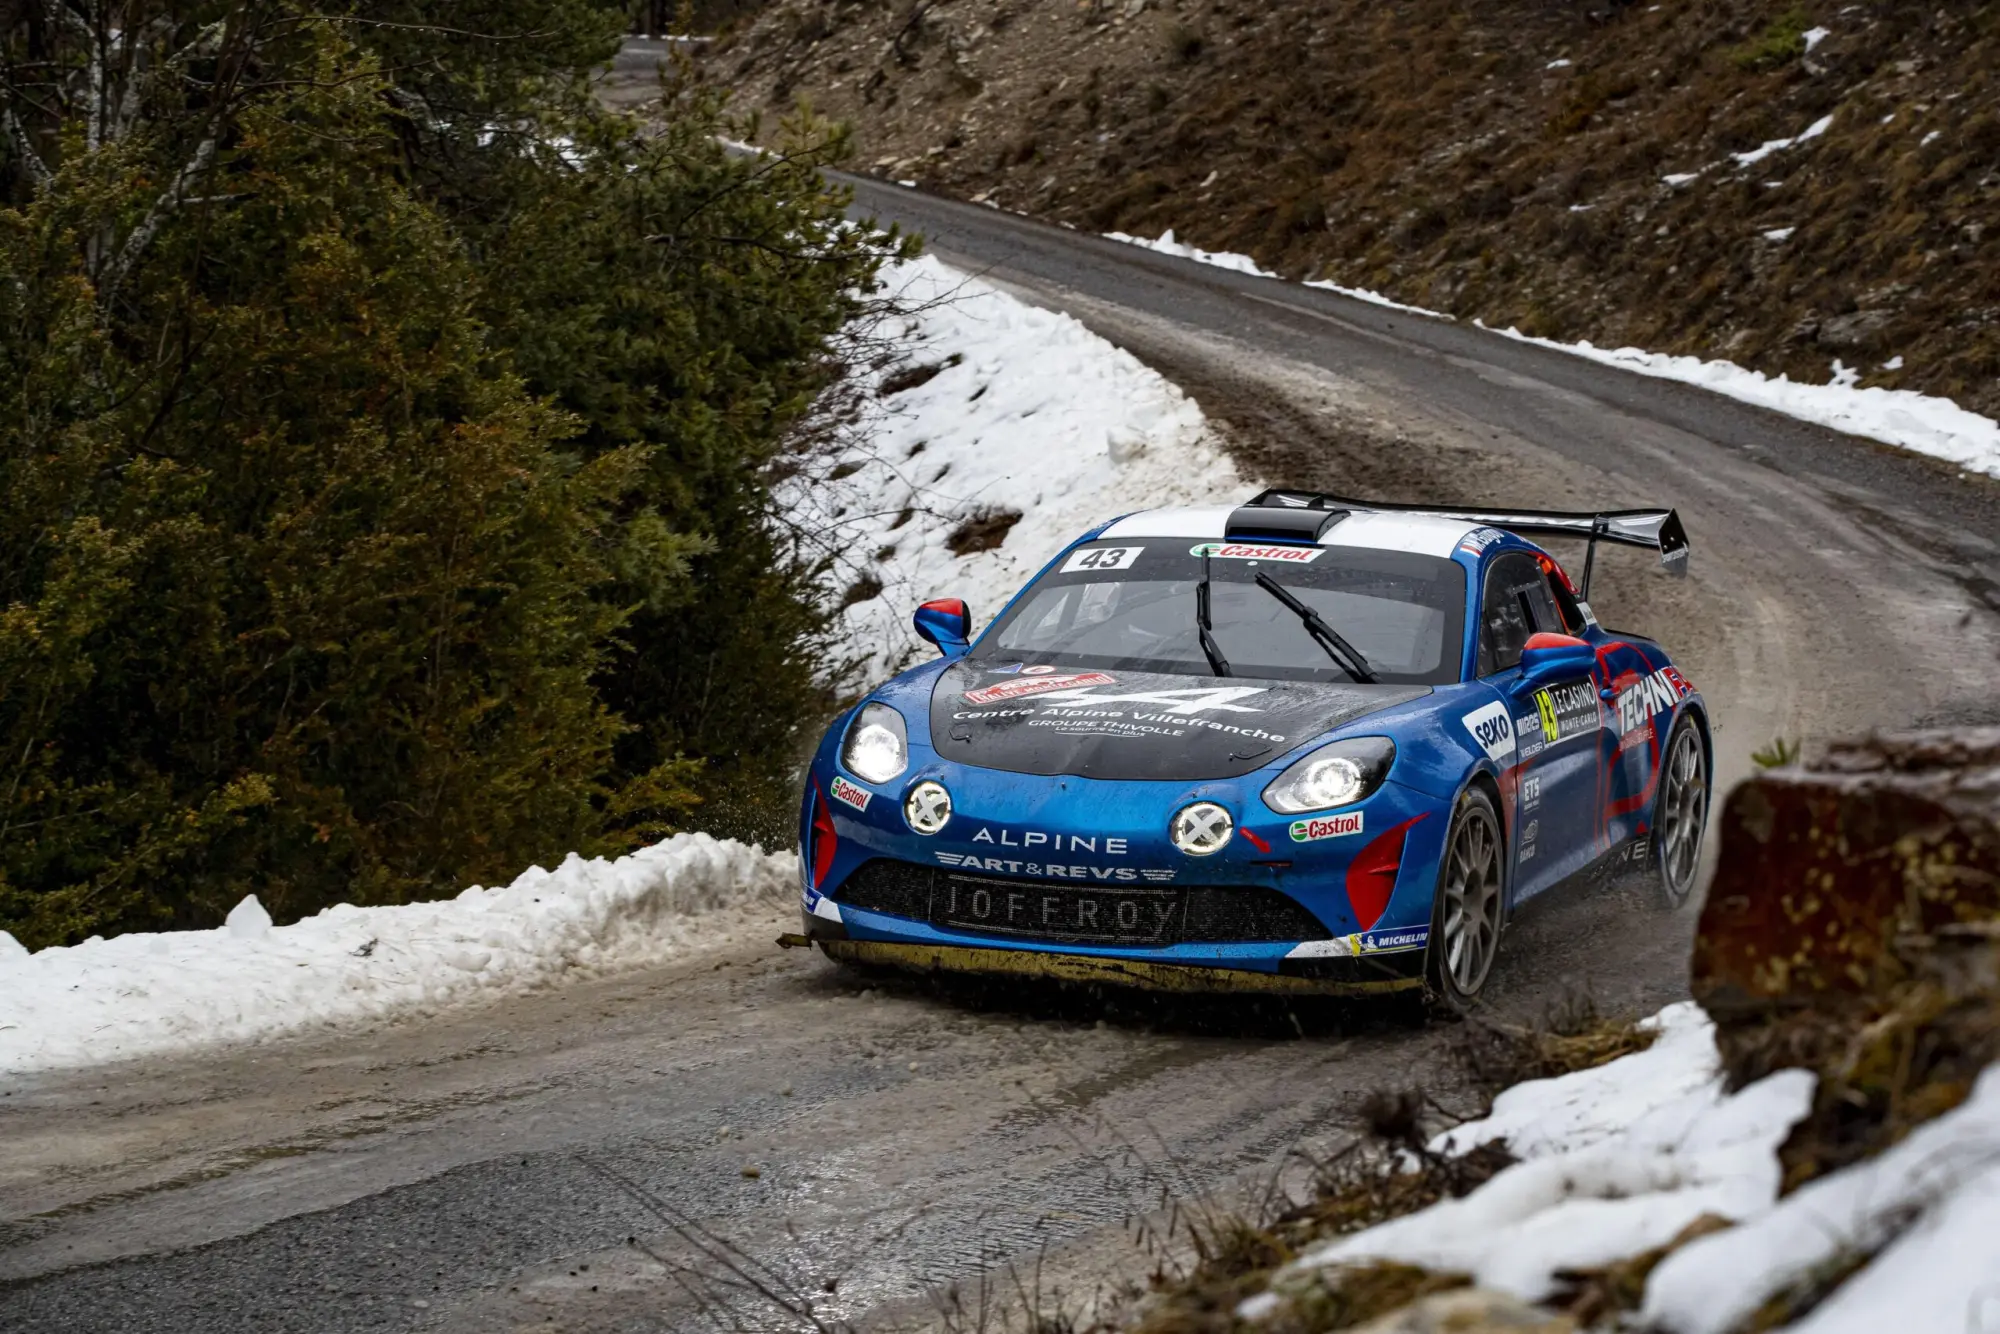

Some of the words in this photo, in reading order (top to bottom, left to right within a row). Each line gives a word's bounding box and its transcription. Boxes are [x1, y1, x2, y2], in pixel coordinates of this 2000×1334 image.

[1079, 548, 1122, 568] 43
[1219, 545, 1313, 561] Castrol
[1565, 682, 1596, 712] CASINO
[953, 708, 1035, 720] Centre
[1040, 708, 1124, 718] Alpine
[1133, 711, 1286, 743] Villefranche
[1028, 719, 1098, 727] GROUPE
[1101, 721, 1185, 737] THIVOLLE
[1535, 690, 1558, 742] 43
[1123, 729, 1145, 737] plus
[837, 782, 868, 808] Castrol
[1524, 777, 1540, 801] ETS
[1308, 815, 1360, 839] Castrol
[972, 827, 1127, 855] ALPINE
[961, 855, 1137, 881] ART&REVS
[1378, 932, 1428, 947] MICHELIN
